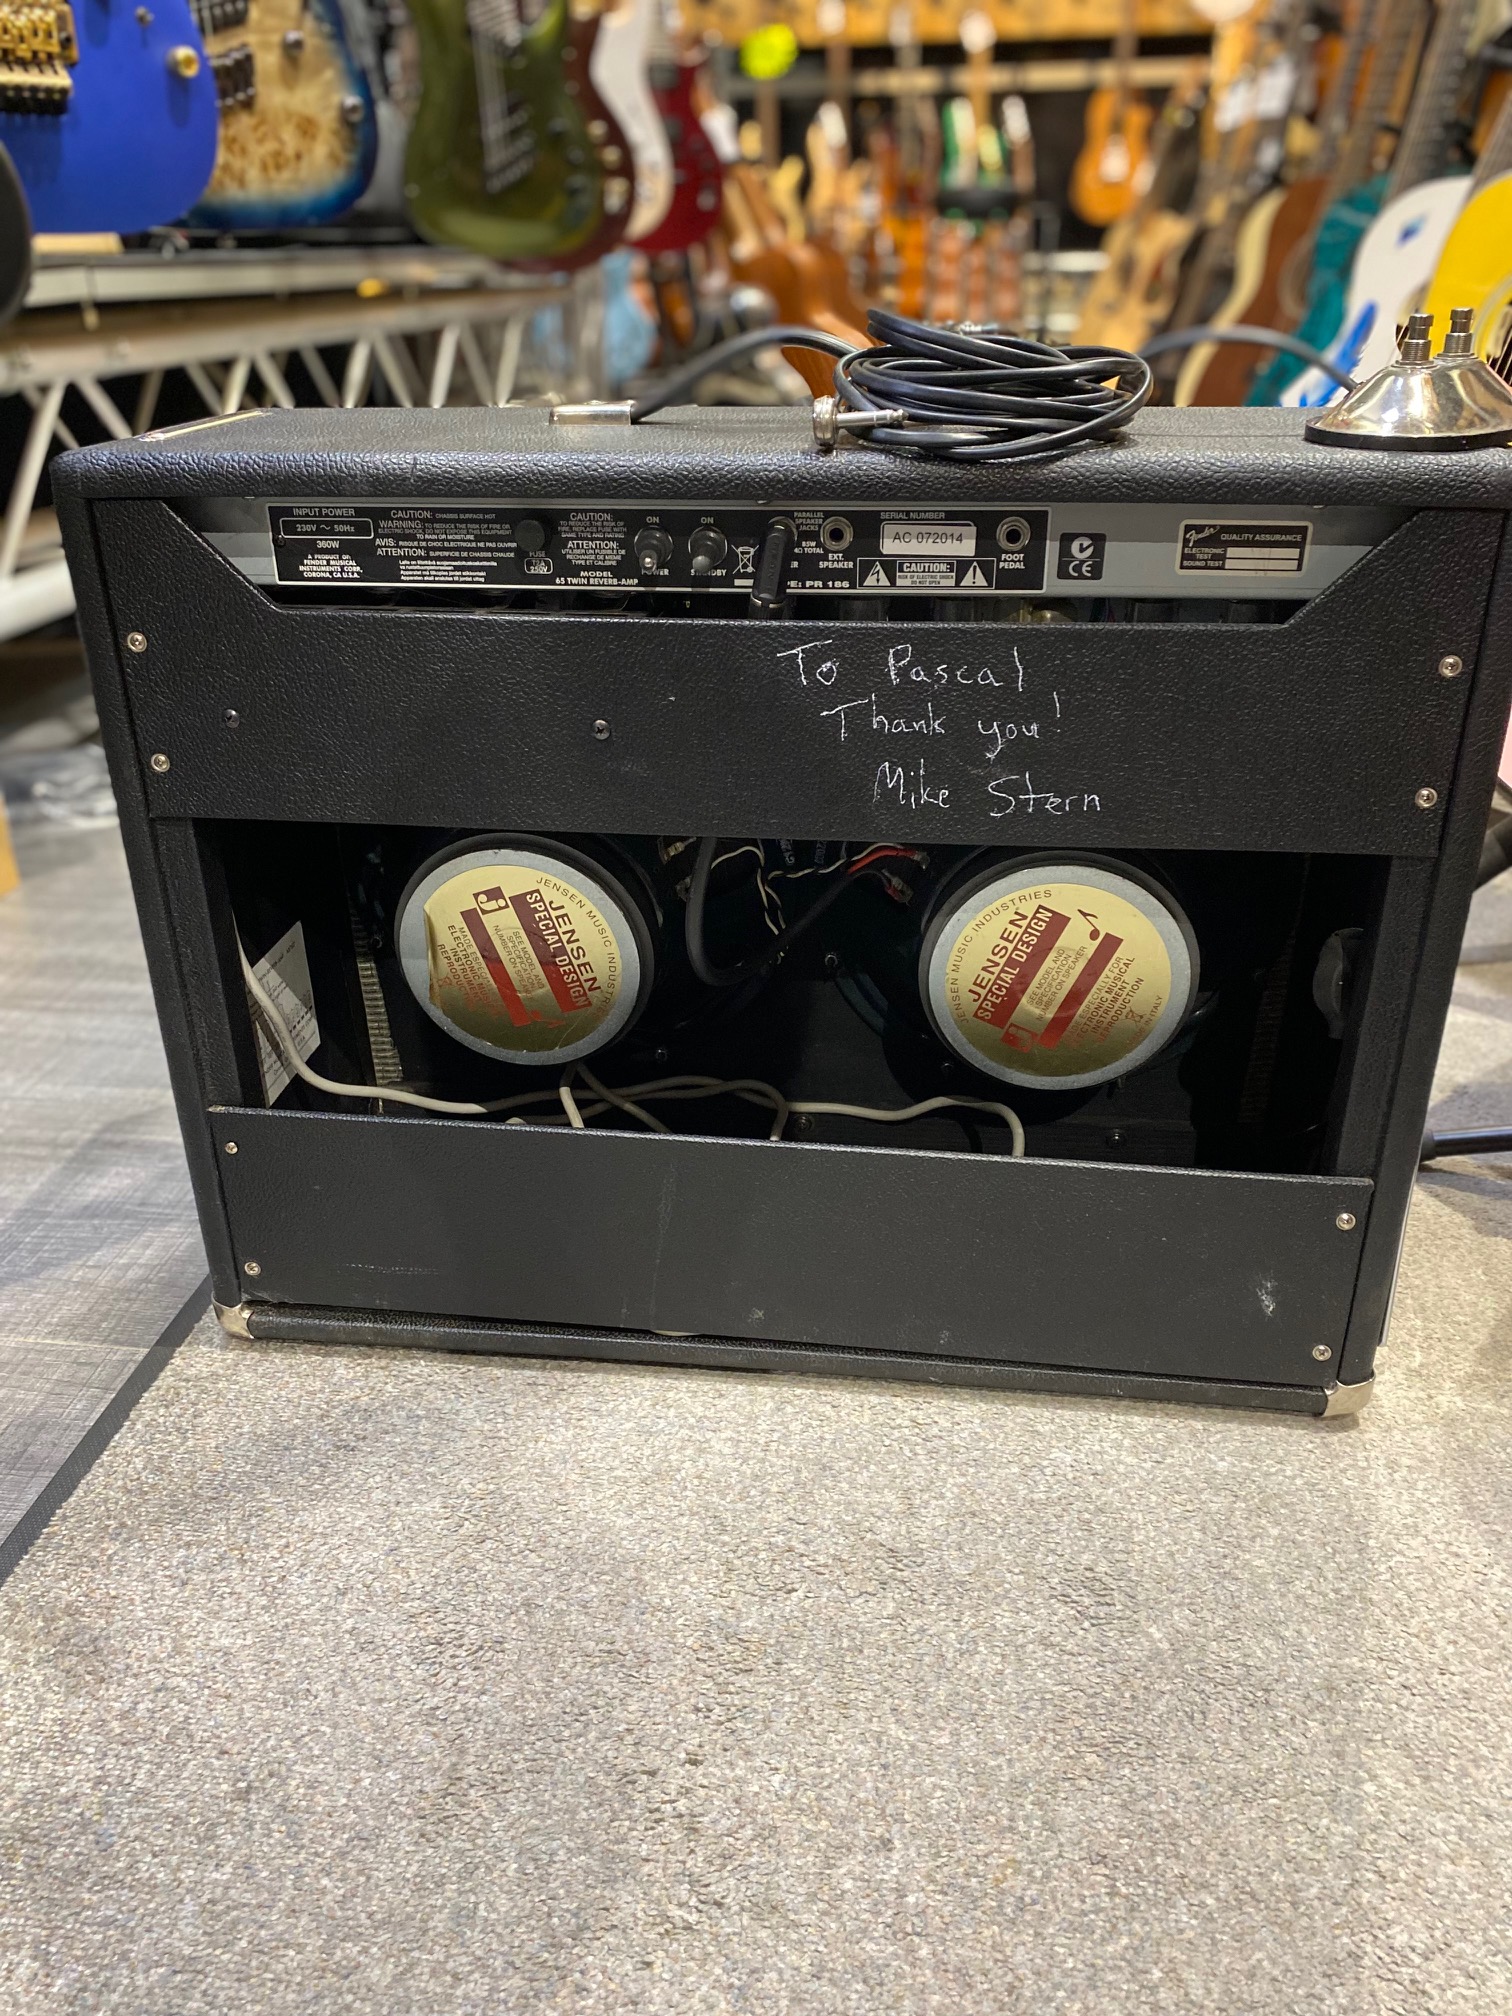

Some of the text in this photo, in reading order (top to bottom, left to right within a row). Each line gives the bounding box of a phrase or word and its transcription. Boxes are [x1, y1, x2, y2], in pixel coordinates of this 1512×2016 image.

[293, 508, 355, 516] INPUT POWER
[379, 520, 424, 528] WARNING:
[391, 510, 433, 519] CAUTION:
[570, 513, 613, 521] CAUTION:
[910, 512, 945, 520] NUMBER
[377, 548, 428, 556] ATTENTION:
[567, 541, 620, 549] ATTENTION:
[892, 531, 964, 544] AC 072014
[1186, 526, 1220, 547] Fender
[819, 561, 854, 569] SPEAKER
[903, 563, 951, 572] CAUTION:
[1069, 561, 1093, 577] CE
[777, 640, 1023, 692] To Pascal
[820, 692, 1062, 762] Thank you!
[873, 759, 1101, 817] Mike Stern
[536, 877, 612, 948] JENSEN MUSIC
[448, 925, 480, 980] ELECTRONIC
[458, 927, 474, 950] MADE
[493, 925, 518, 969] NUMBER ON
[513, 931, 524, 948] SEE
[520, 946, 536, 973] MODEL
[525, 892, 589, 1009] SPECIAL DESIGN
[549, 900, 601, 992] JENSEN
[950, 889, 1052, 1024] JENSEN MUSIC INDUSTRIES
[968, 911, 1029, 1003] JENSEN
[977, 909, 1053, 1020] SPECIAL DESIGN
[1027, 948, 1065, 1006] SEE MODEL AND
[1035, 953, 1072, 1007] SPECIFICATION
[1036, 945, 1088, 1022] NUMBER ON SPEAKER
[1105, 957, 1136, 996] MUSICAL
[1080, 956, 1123, 1021] ESPECIALLY FOR
[1090, 979, 1130, 1034] INSTRUMENT
[1149, 994, 1163, 1018] ITALY
